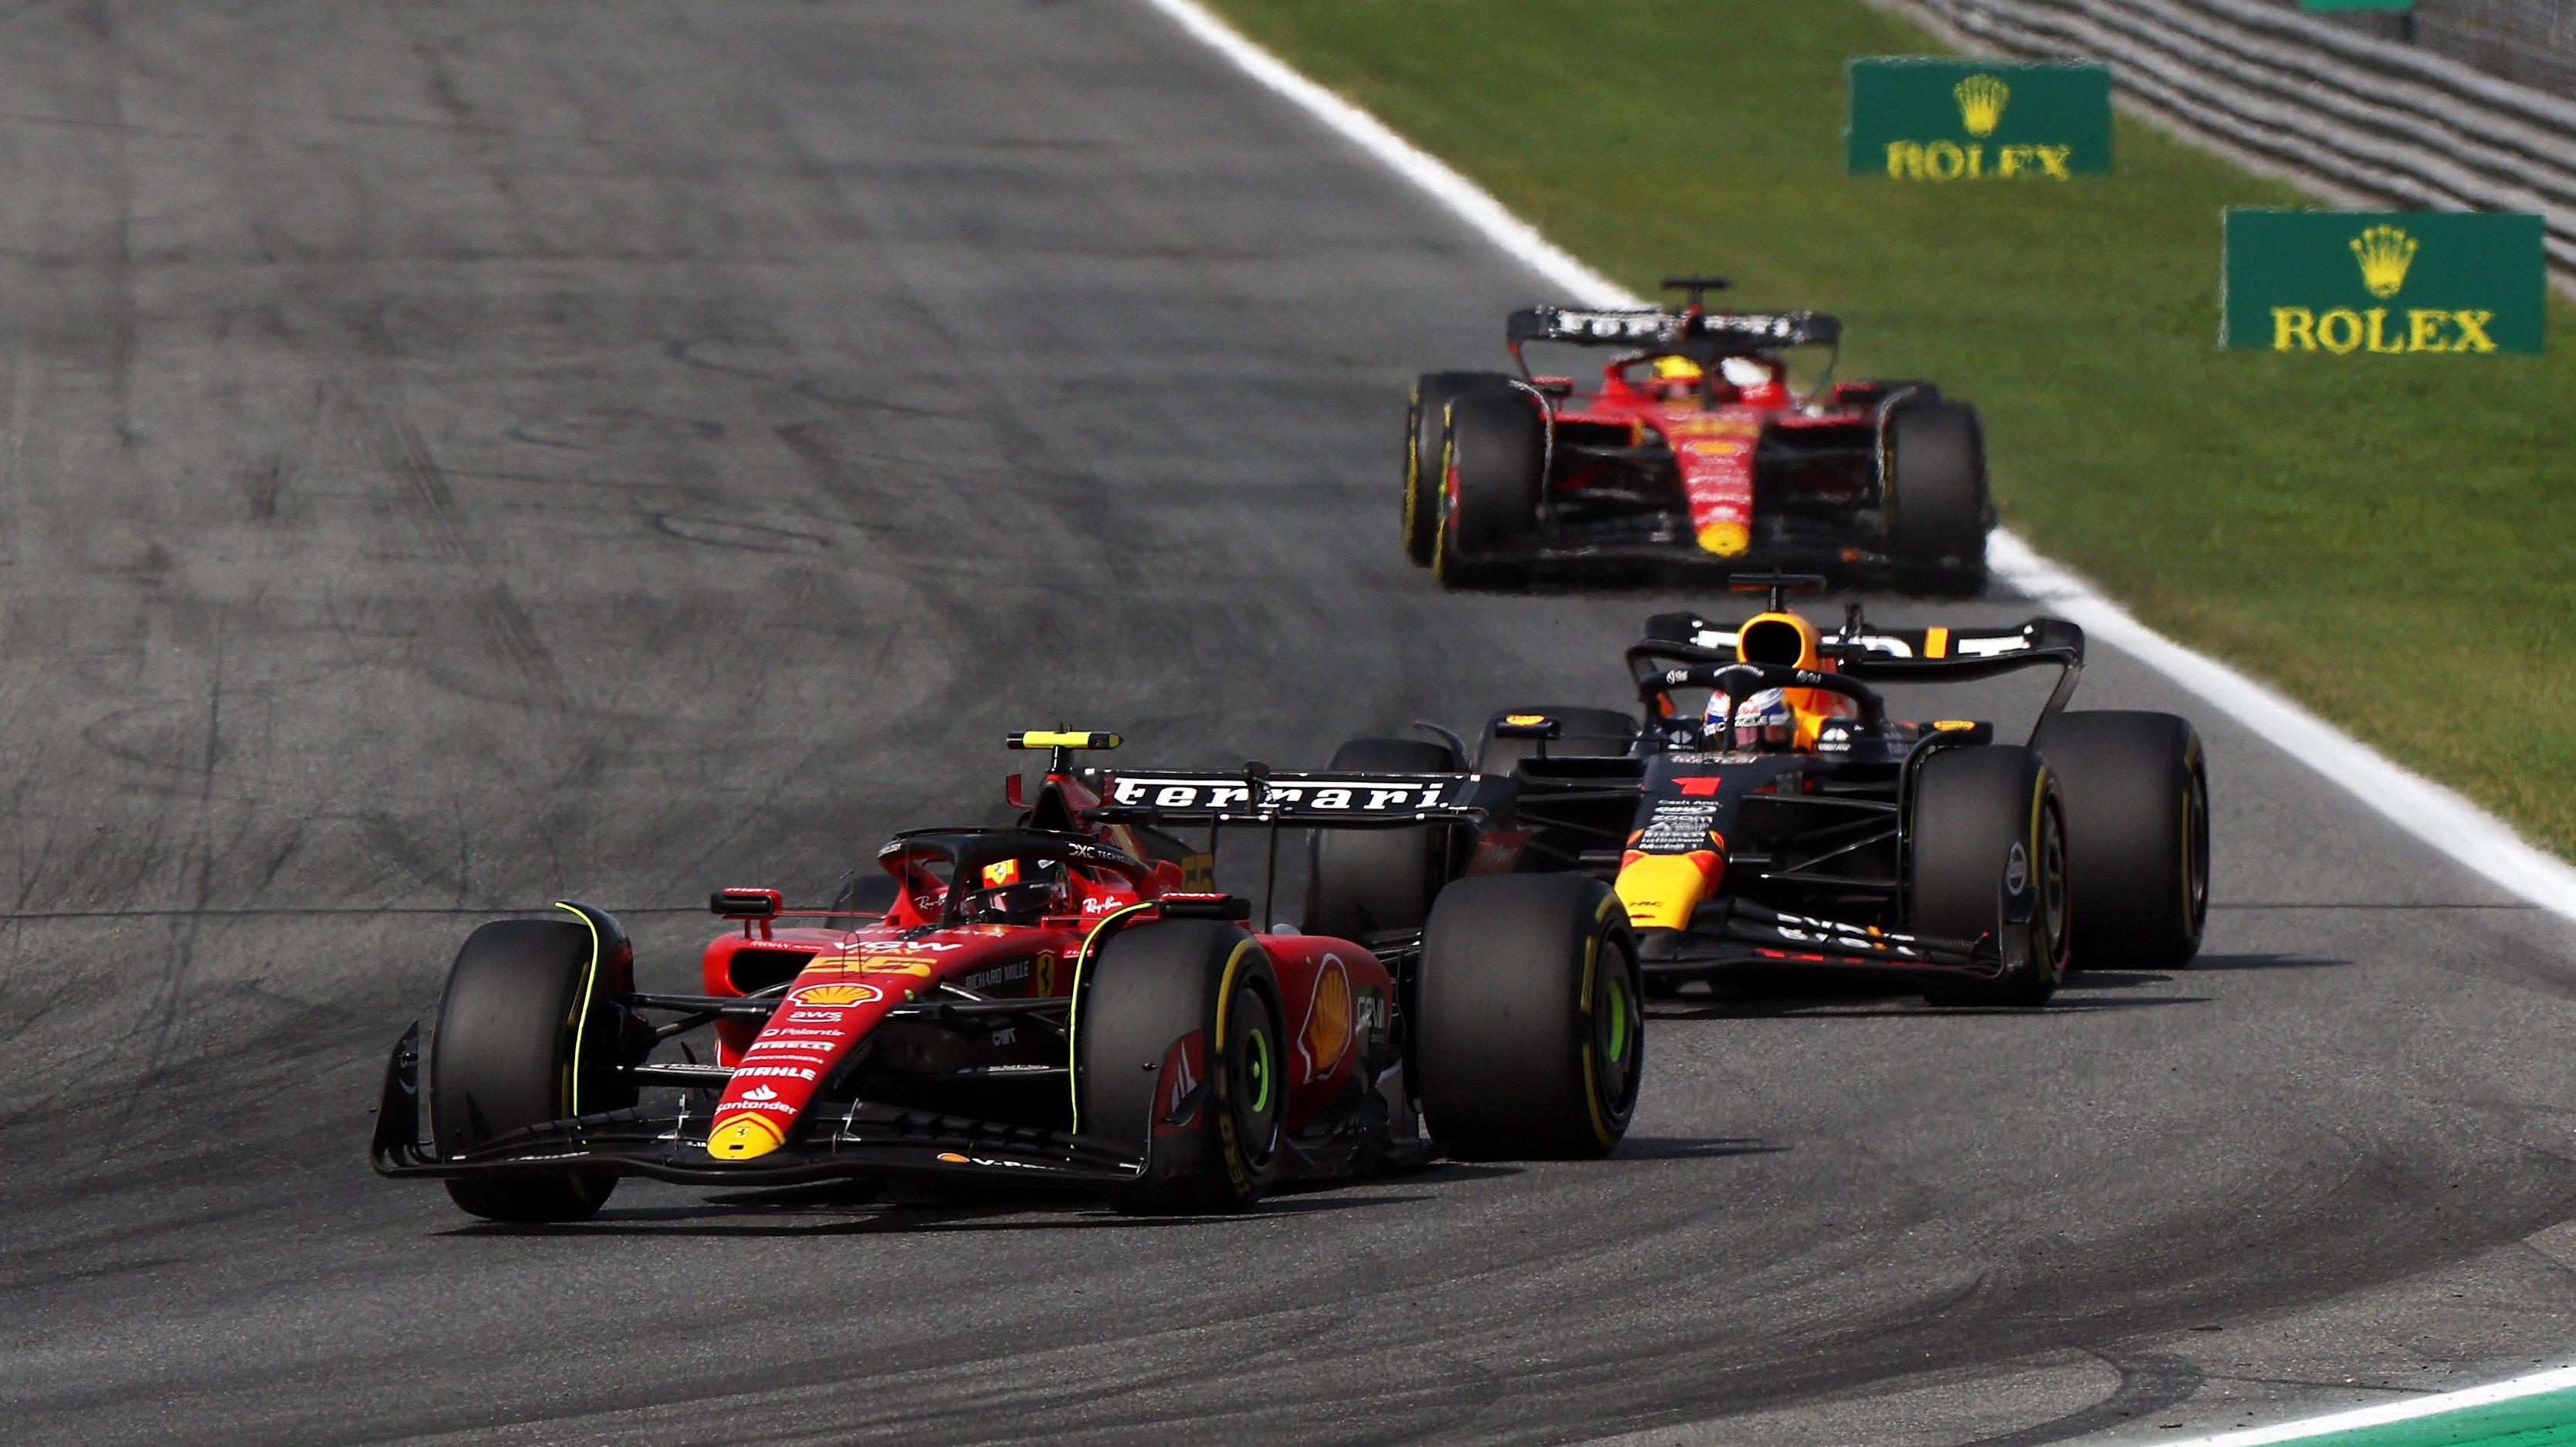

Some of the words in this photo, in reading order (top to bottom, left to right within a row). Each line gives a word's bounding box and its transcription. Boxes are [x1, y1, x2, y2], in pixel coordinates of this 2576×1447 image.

[2269, 305, 2499, 355] ROLEX
[1113, 777, 1444, 809] Ferrari
[1671, 777, 1722, 796] 1
[834, 941, 963, 951] VGW
[800, 956, 938, 978] 55
[965, 968, 1002, 989] RICHARD
[1005, 961, 1030, 981] MILLE
[789, 1011, 844, 1020] aws
[780, 1028, 845, 1037] Palantir
[730, 1066, 817, 1082] MAHLE
